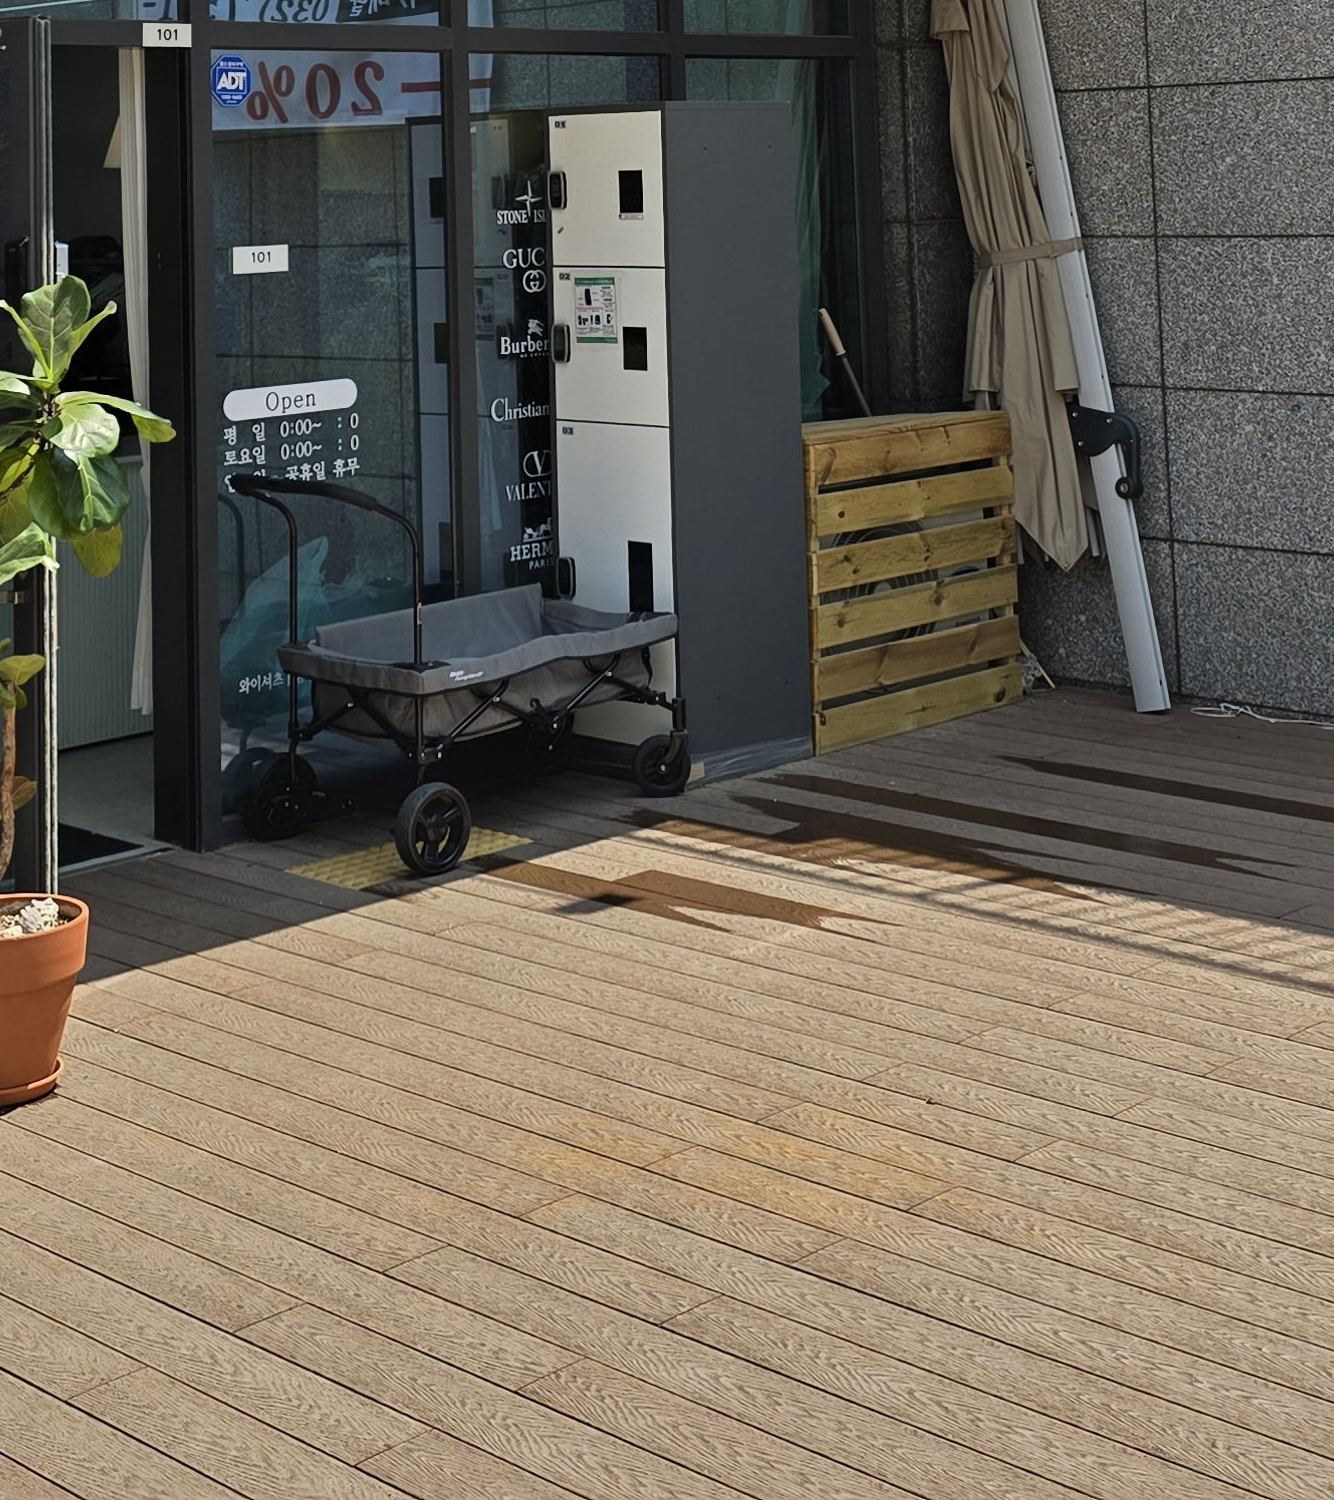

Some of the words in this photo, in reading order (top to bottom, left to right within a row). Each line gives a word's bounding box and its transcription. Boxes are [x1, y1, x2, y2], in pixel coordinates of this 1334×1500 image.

[157, 28, 178, 41] 101
[217, 71, 247, 90] ADT
[496, 209, 529, 225] STONE
[251, 251, 272, 263] 101
[265, 391, 317, 413] Open
[490, 396, 550, 422] Christian
[223, 444, 266, 466] 토요일
[238, 671, 284, 695] 와이셔츠
